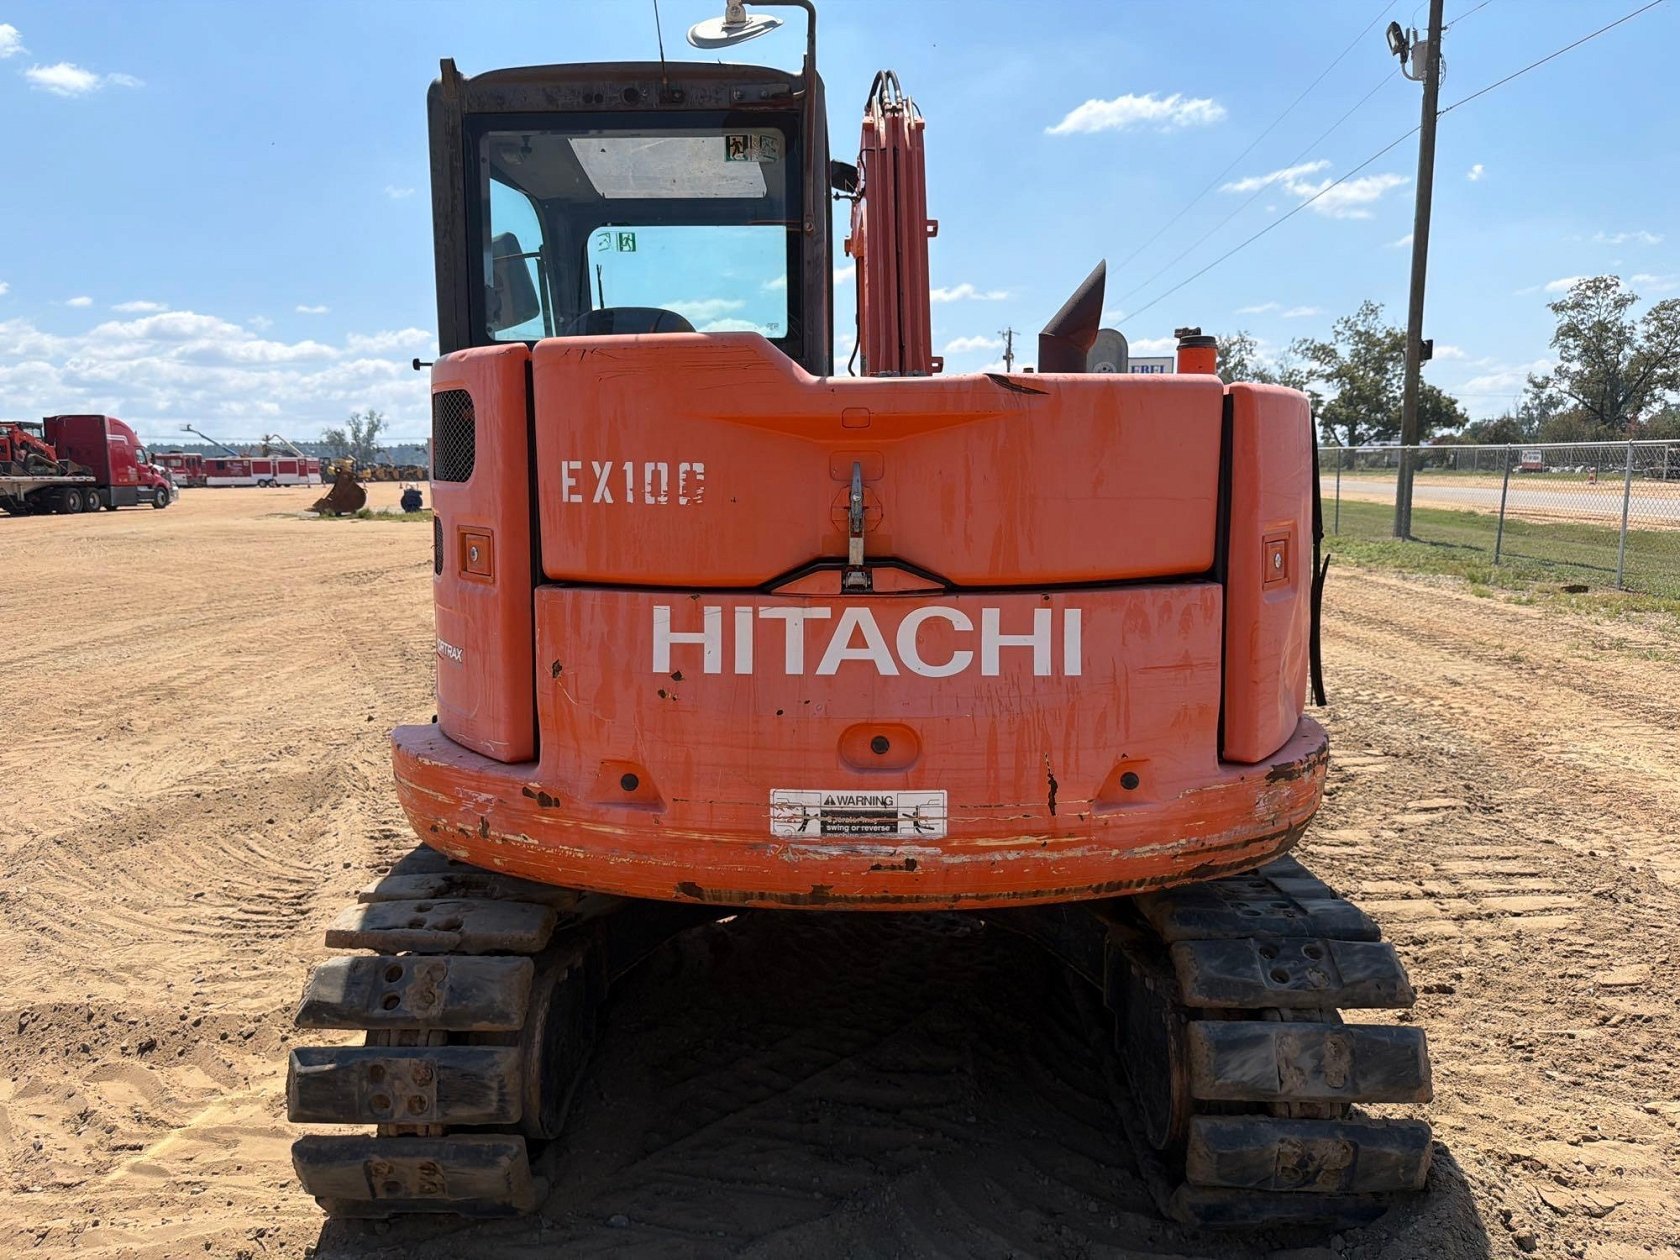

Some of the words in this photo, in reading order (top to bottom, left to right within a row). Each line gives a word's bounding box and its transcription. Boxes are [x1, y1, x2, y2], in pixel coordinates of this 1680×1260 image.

[653, 605, 1082, 678] HITACHI
[836, 795, 893, 806] WARNING
[826, 824, 849, 832] swing
